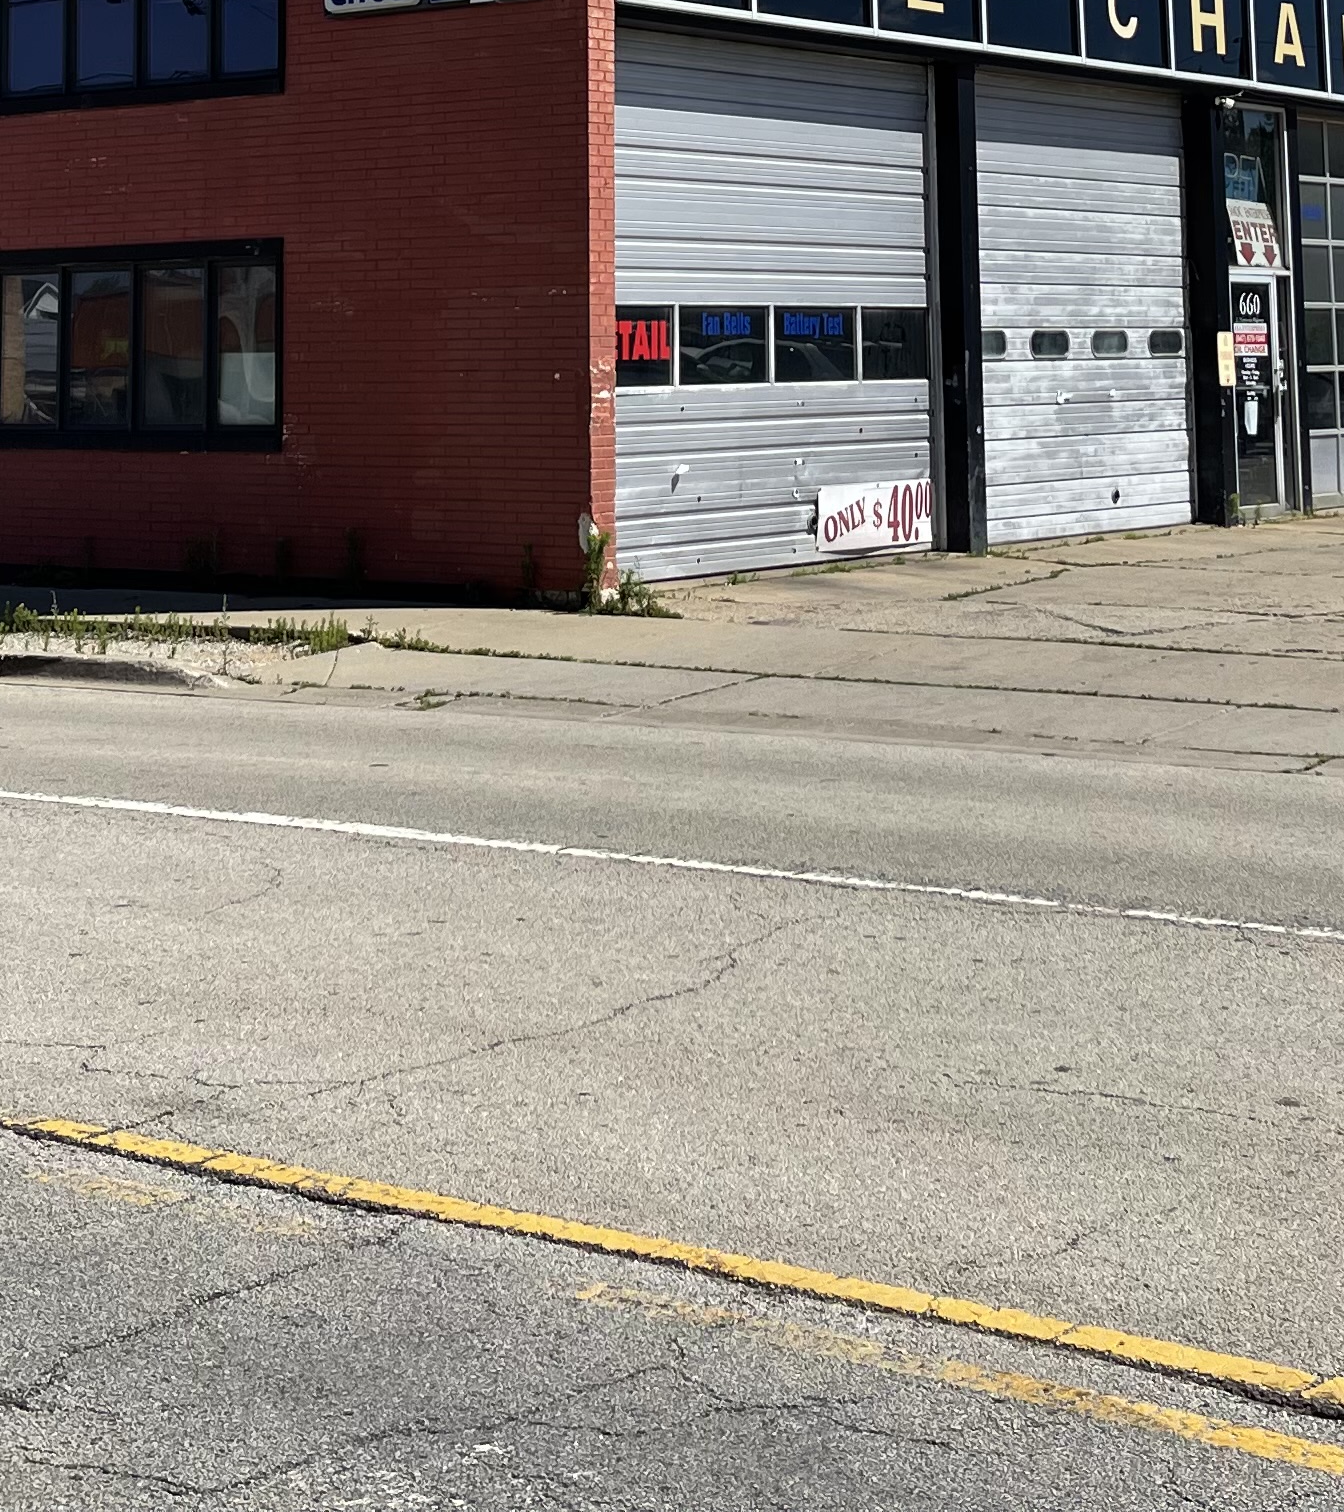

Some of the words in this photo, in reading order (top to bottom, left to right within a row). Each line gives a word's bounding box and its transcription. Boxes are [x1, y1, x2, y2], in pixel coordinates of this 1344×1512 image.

[1231, 219, 1277, 243] ENTER
[1239, 292, 1260, 315] 660
[702, 313, 720, 335] Fan
[724, 312, 751, 336] Belts
[783, 312, 820, 339] Battery
[822, 312, 844, 336] Test
[616, 320, 670, 361] TAIL
[824, 497, 866, 543] ONLY
